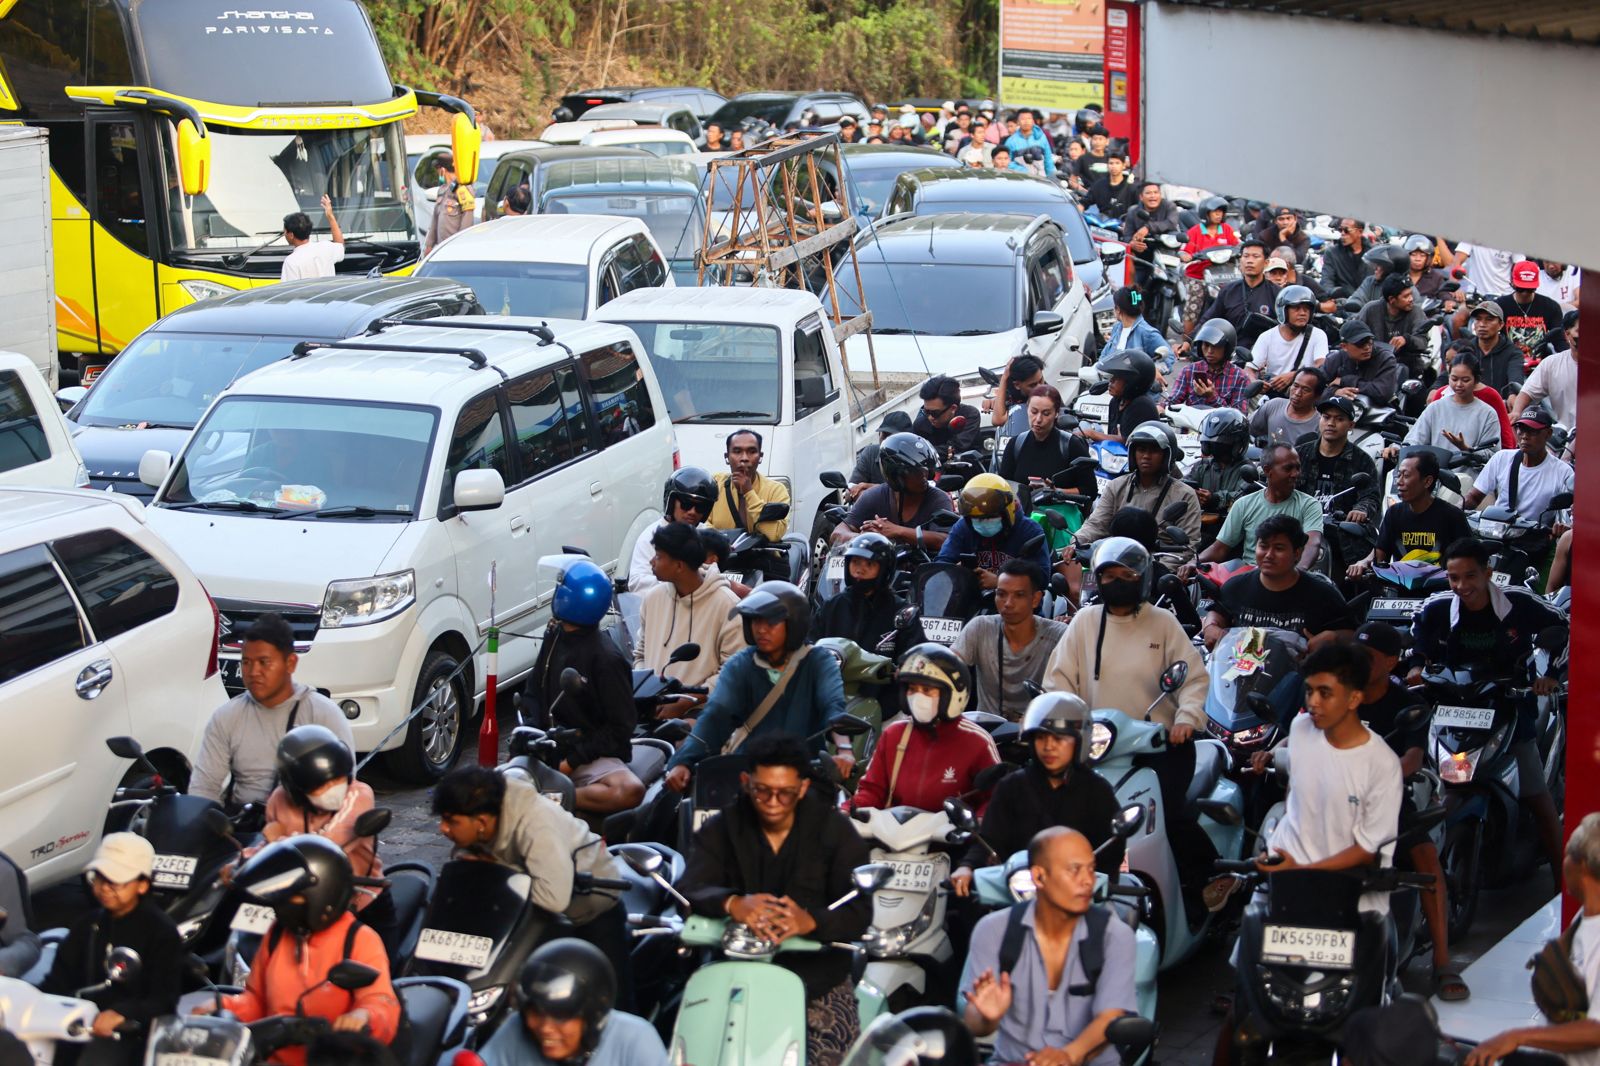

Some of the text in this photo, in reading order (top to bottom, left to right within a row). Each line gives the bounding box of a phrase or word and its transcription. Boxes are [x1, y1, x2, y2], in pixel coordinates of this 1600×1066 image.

[1374, 600, 1386, 609] DK
[921, 620, 940, 630] 967
[154, 857, 191, 872] 24FCE
